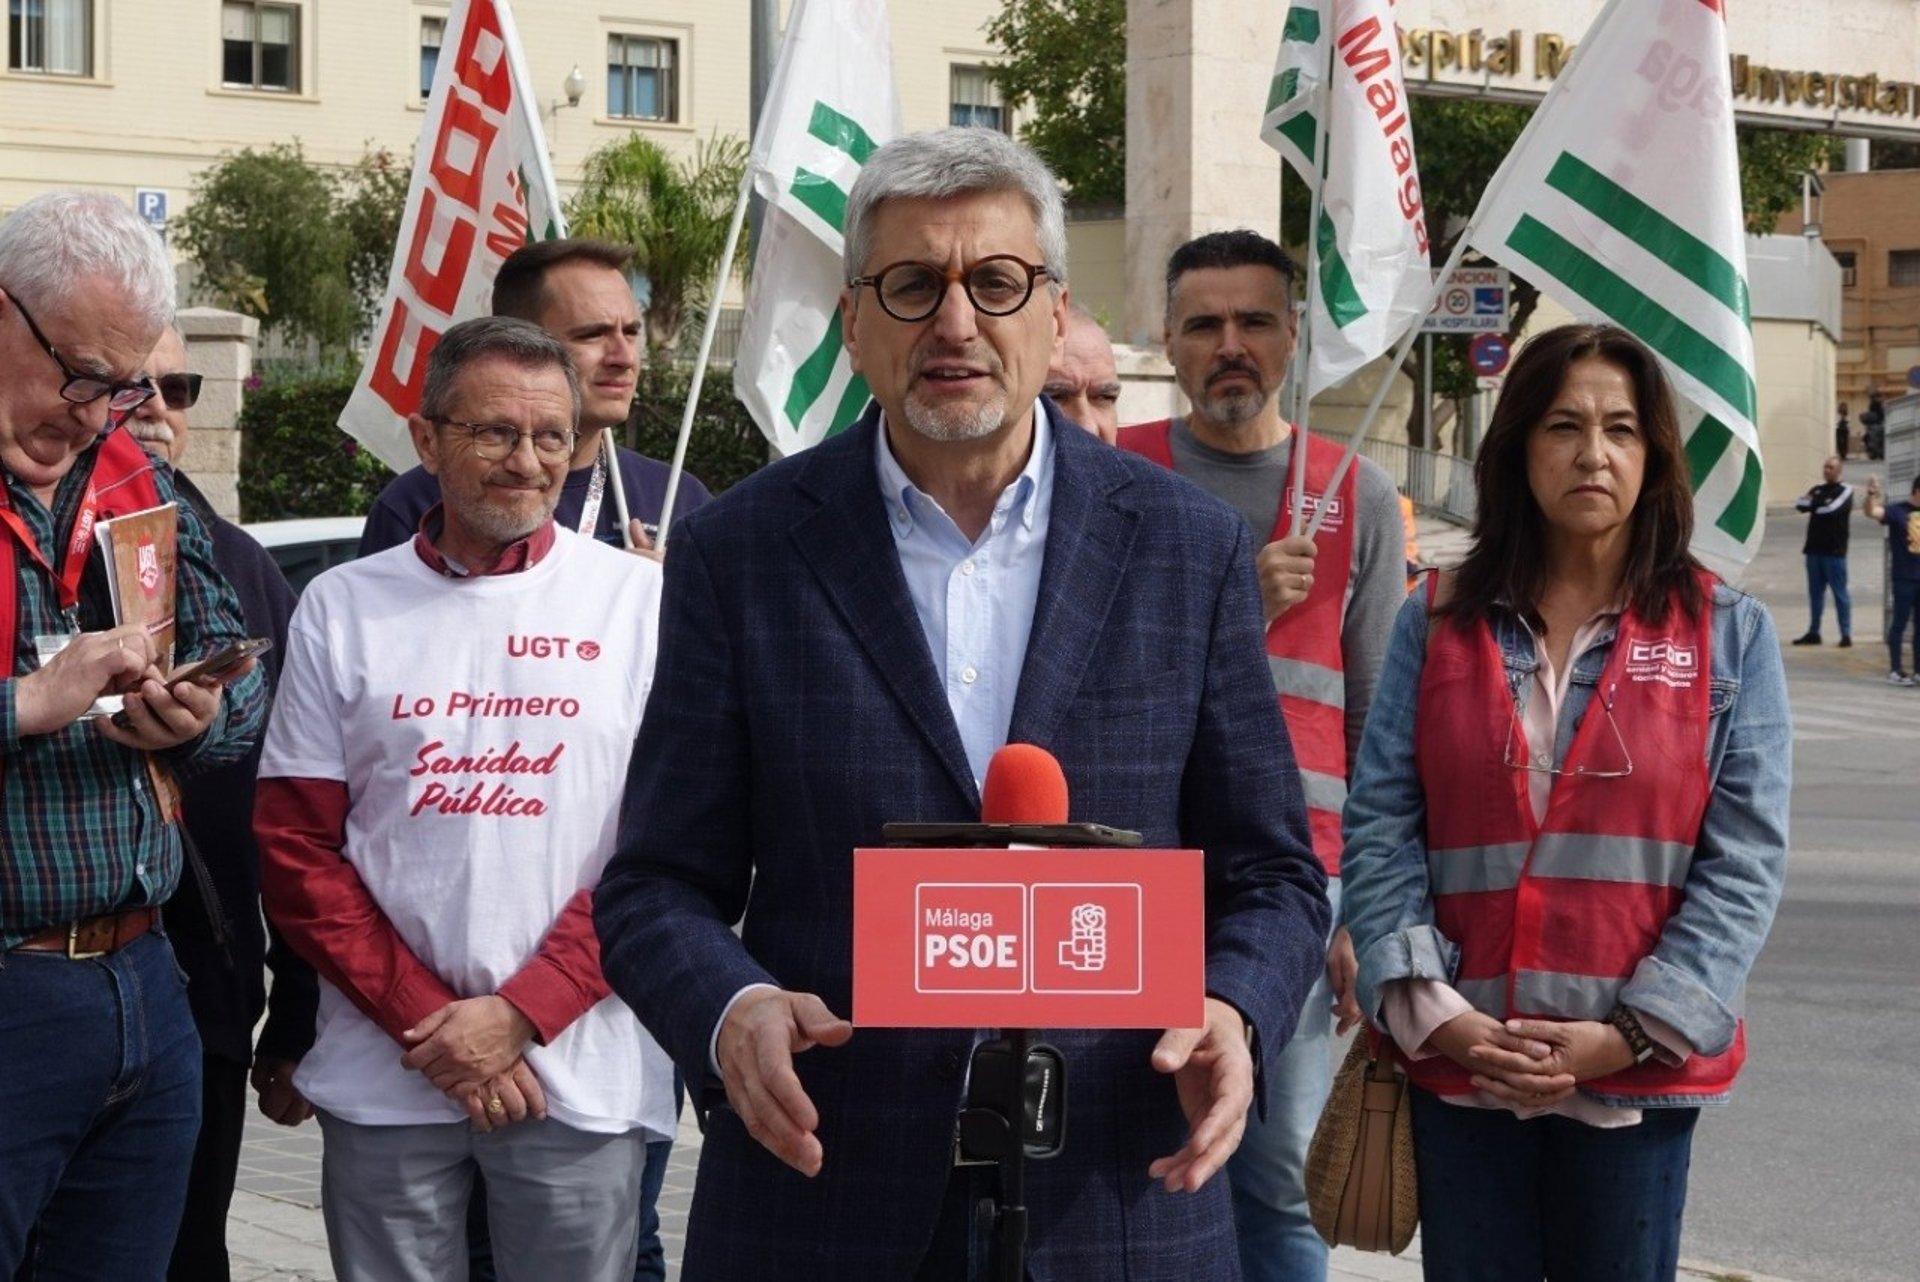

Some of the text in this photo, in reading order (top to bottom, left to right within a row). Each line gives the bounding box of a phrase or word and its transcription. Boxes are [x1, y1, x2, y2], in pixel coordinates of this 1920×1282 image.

[507, 635, 570, 659] UGT
[1632, 643, 1692, 667] CCOO
[392, 691, 580, 719] Lo Primero
[409, 741, 565, 777] Sanidad
[409, 780, 548, 817] Pública
[925, 907, 994, 931] Málaga
[925, 934, 1018, 968] PSOE
